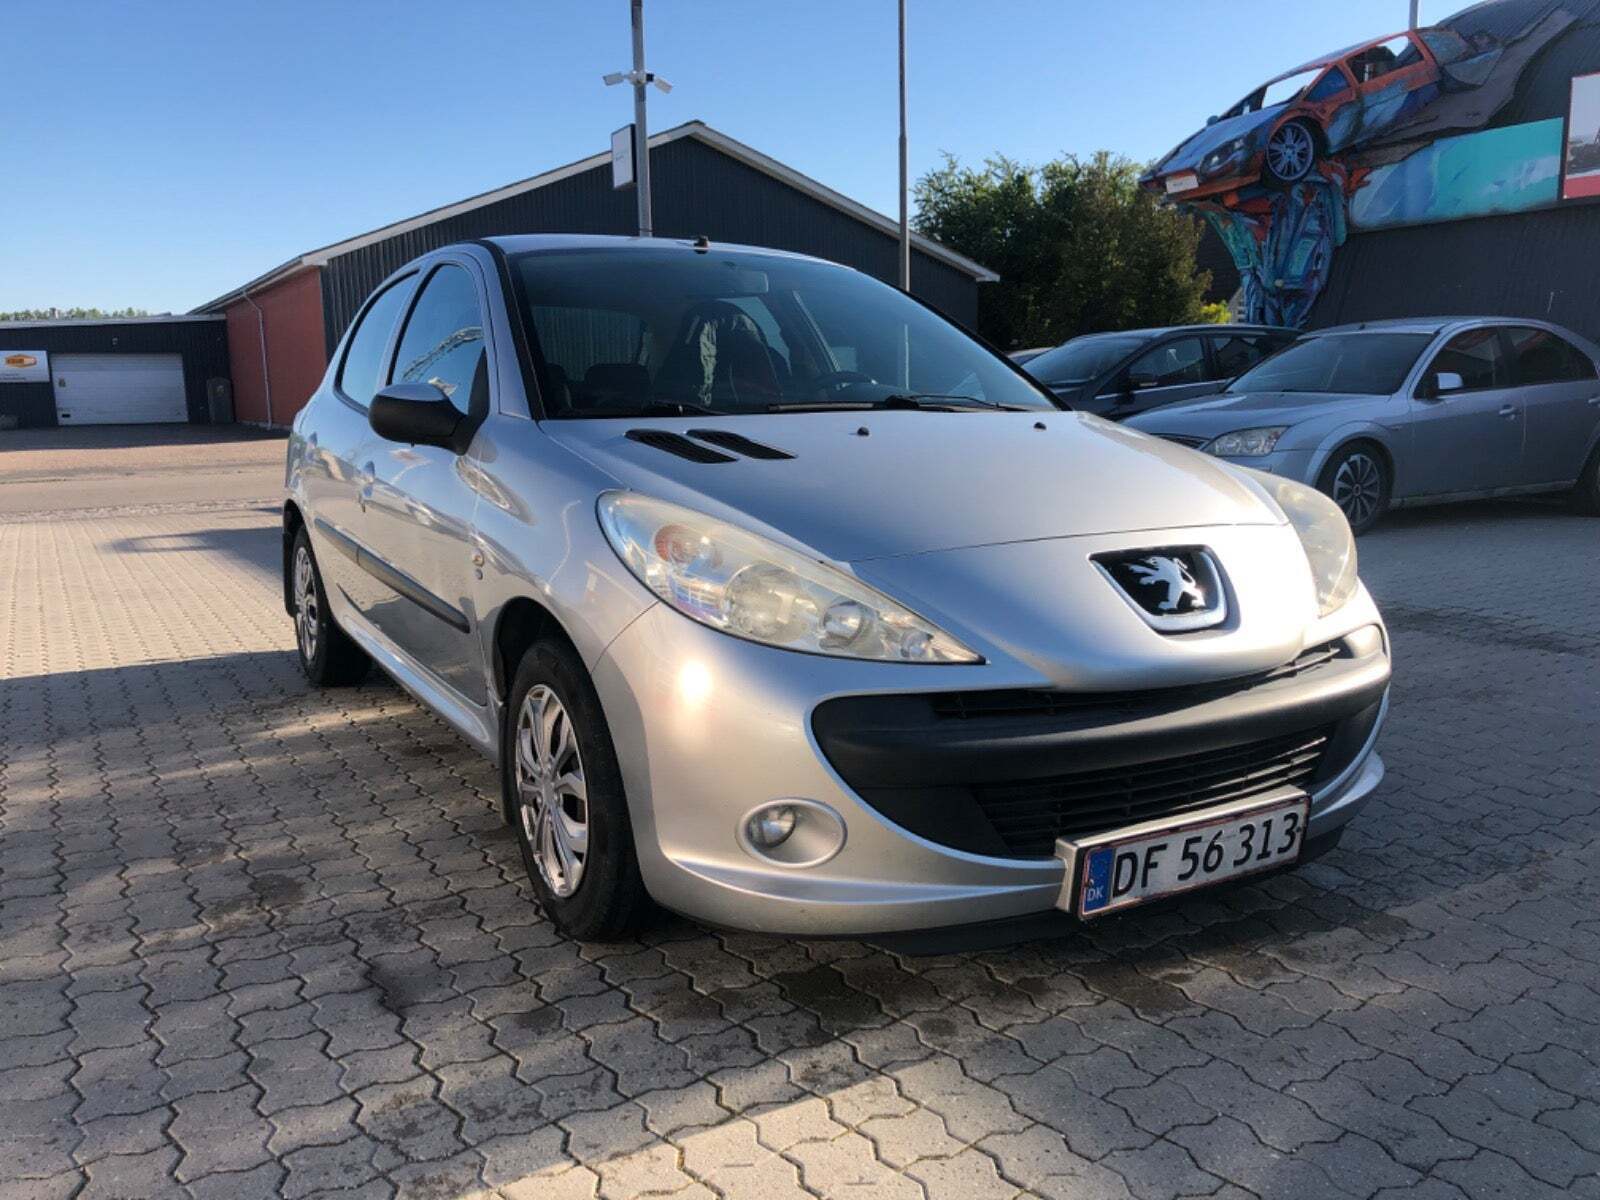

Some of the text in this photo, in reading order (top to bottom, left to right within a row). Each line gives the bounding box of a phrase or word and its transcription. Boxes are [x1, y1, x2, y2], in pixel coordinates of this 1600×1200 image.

[1113, 812, 1299, 897] DF 56 313
[1087, 885, 1104, 901] DK
